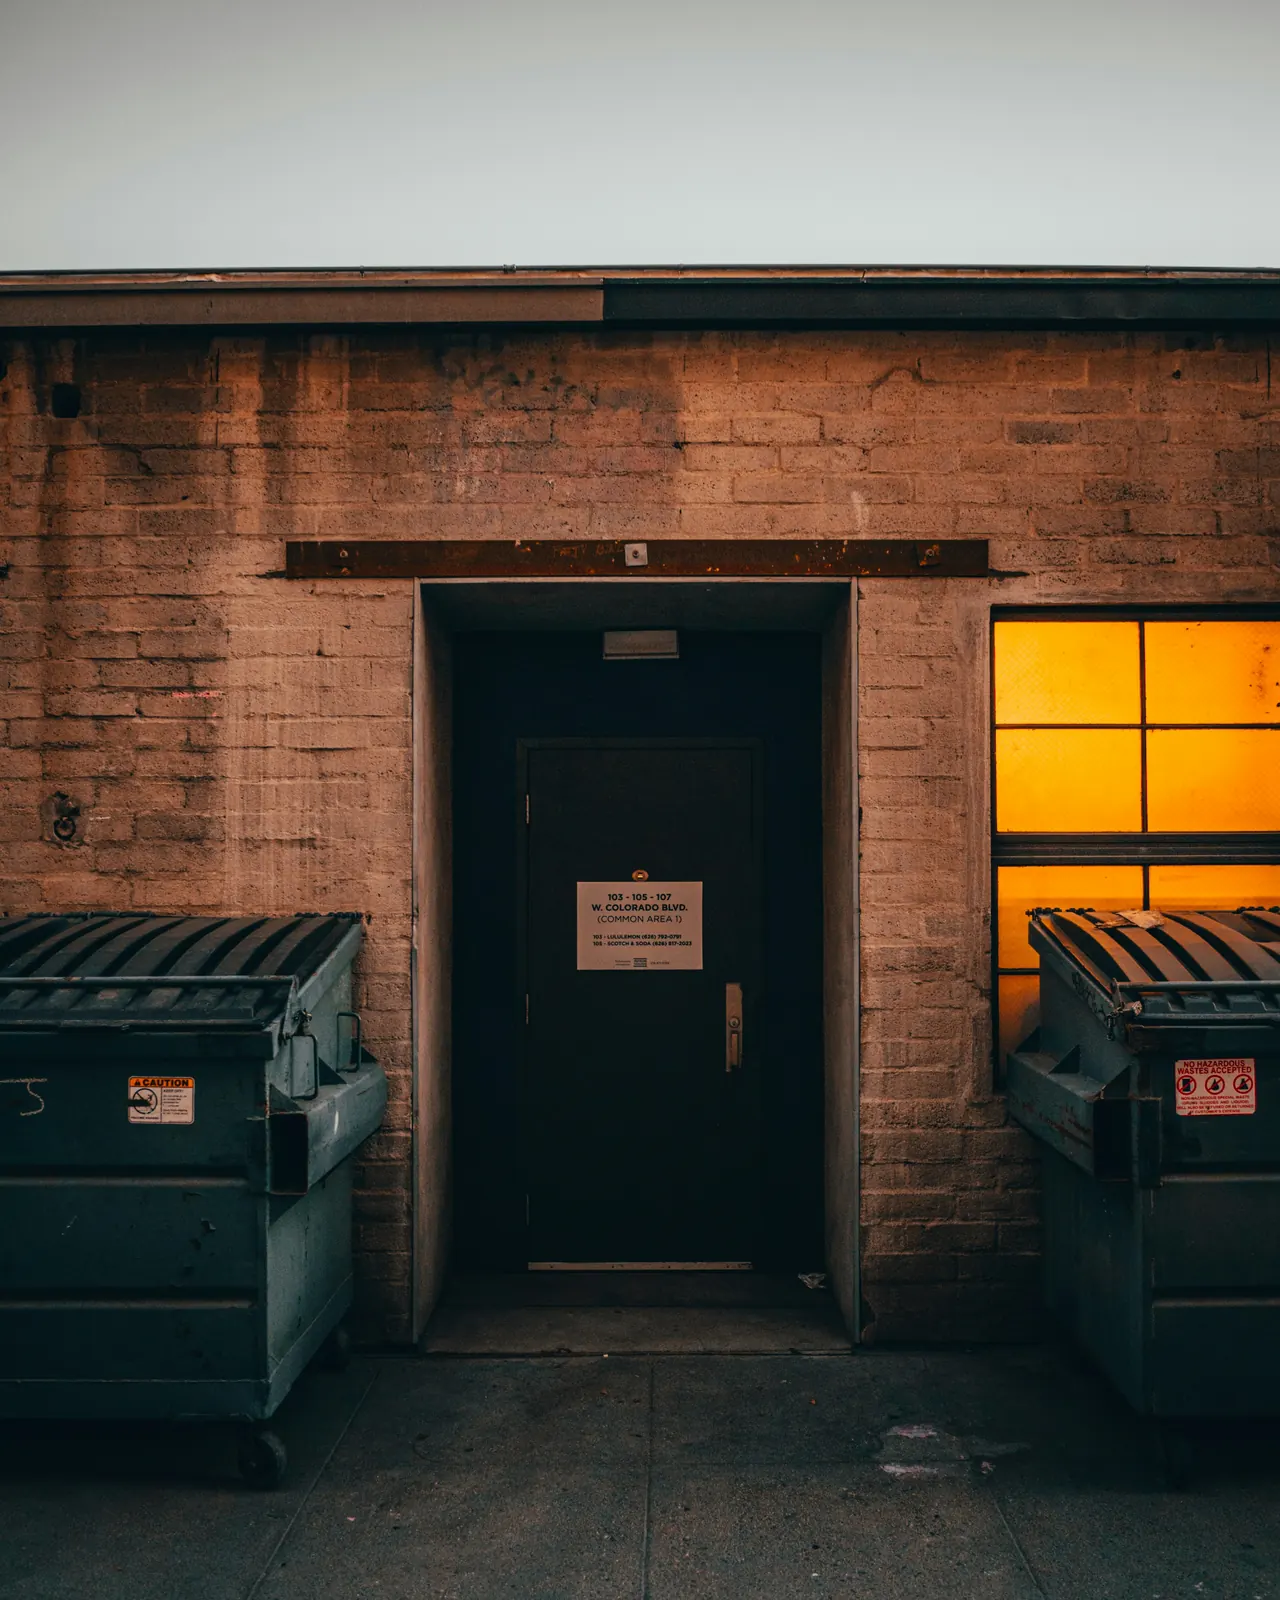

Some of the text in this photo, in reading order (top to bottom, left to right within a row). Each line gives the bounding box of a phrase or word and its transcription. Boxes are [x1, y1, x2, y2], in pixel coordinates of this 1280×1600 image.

[608, 893, 624, 901] 103
[632, 893, 648, 901] 105
[656, 893, 672, 901] 107
[591, 903, 688, 912] W. COLORADO BLVD.
[597, 915, 683, 923] (COMMON AREA 1)
[1210, 1066, 1252, 1074] ACCEPTED
[142, 1079, 189, 1087] CAUTION
